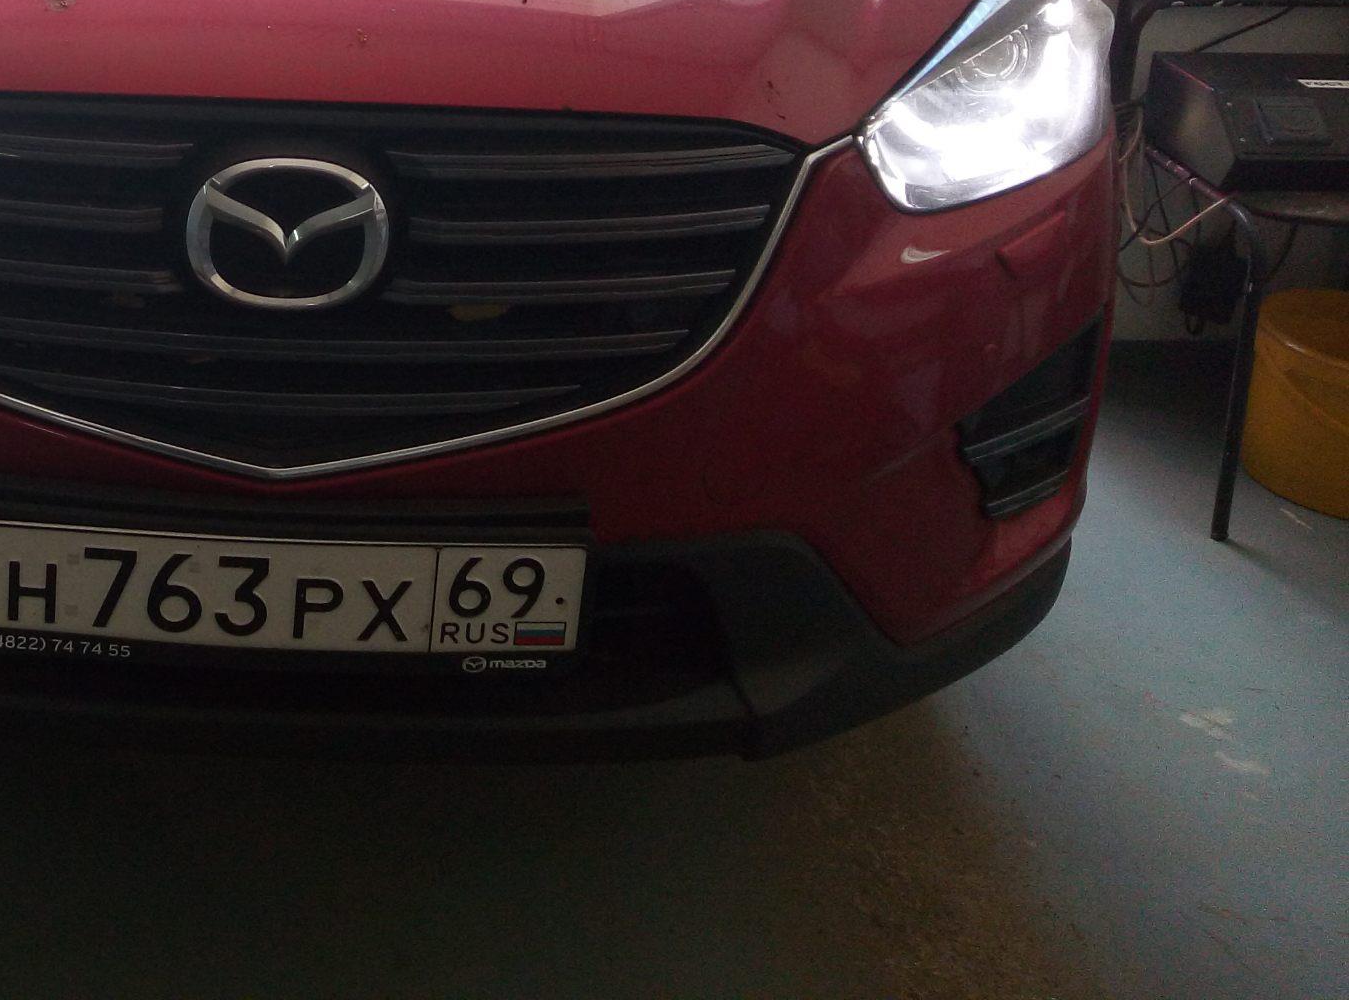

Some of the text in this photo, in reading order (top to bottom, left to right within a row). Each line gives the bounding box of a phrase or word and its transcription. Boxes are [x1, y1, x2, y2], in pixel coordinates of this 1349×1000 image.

[447, 556, 546, 620] 69
[439, 621, 510, 645] RUS
[52, 638, 74, 653] 74
[80, 641, 102, 655] 74
[109, 644, 131, 657] 55
